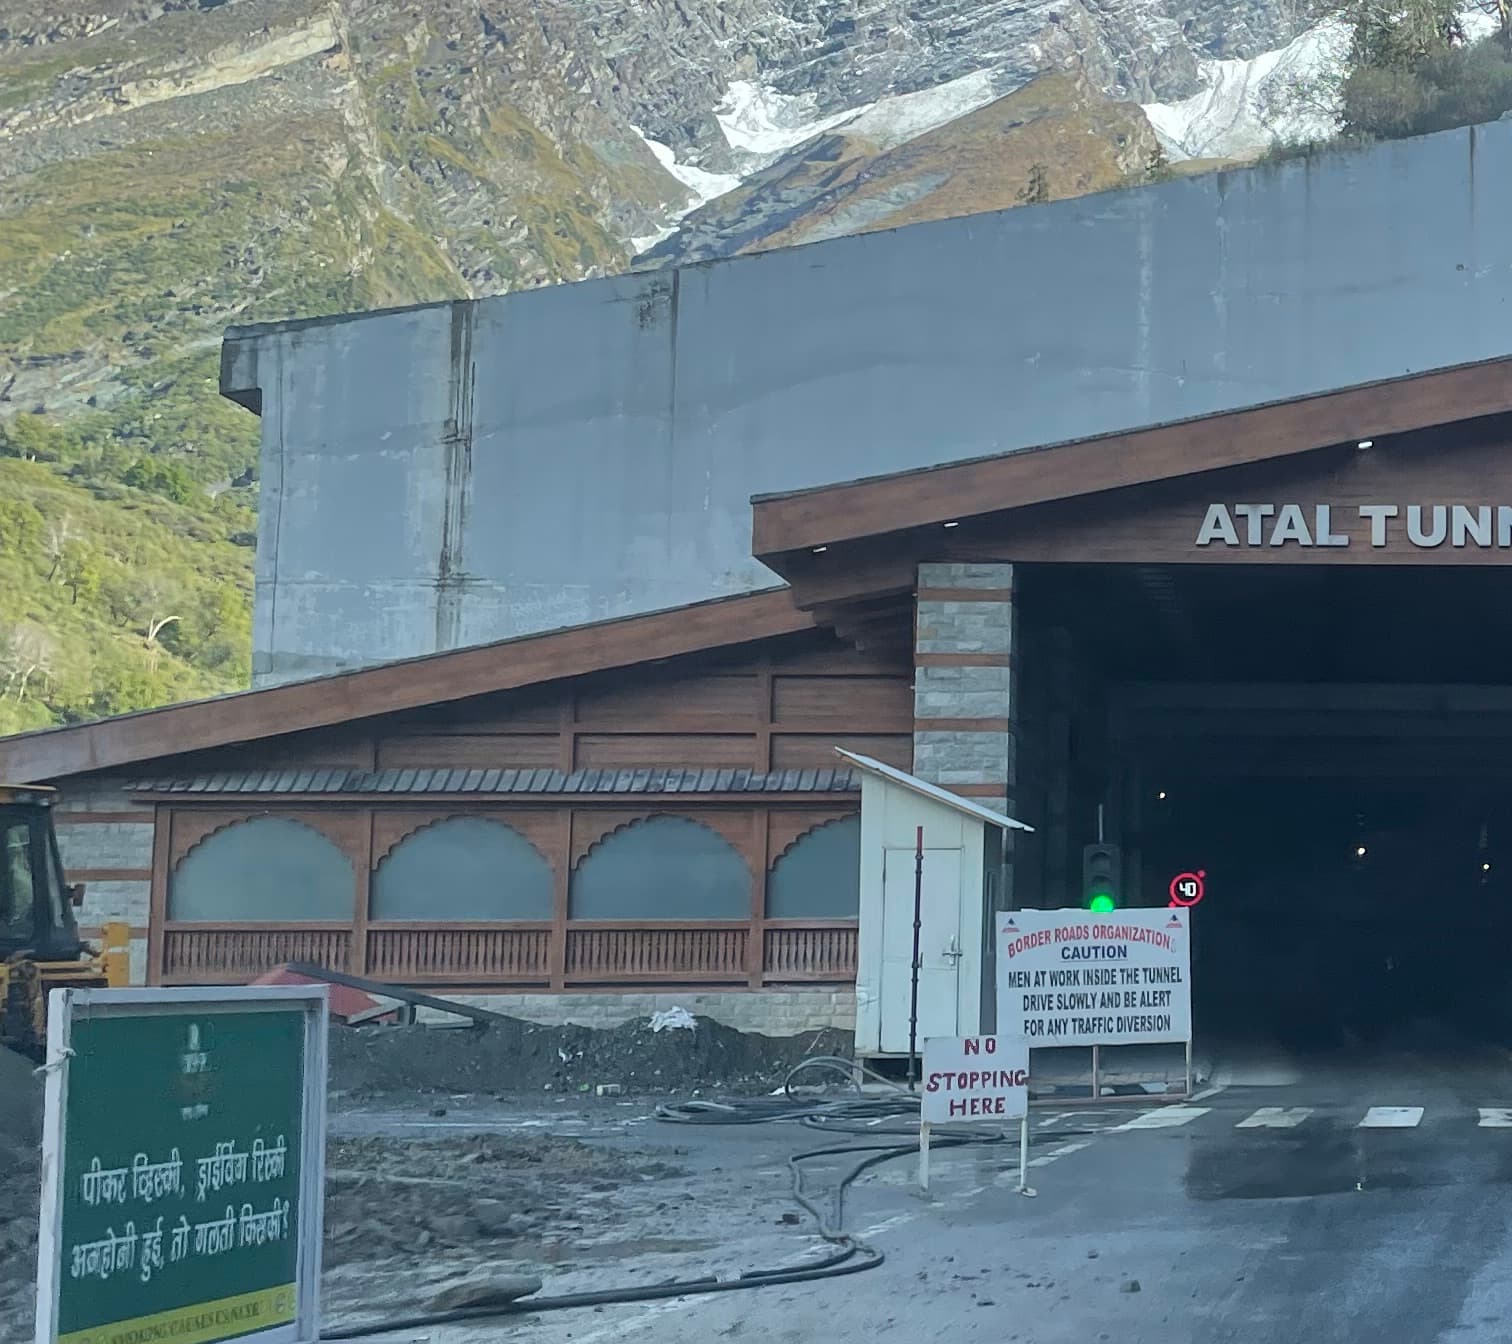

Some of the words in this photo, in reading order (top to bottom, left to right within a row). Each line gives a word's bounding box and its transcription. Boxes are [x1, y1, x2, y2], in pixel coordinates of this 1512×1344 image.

[1195, 503, 1350, 547] ATAL
[1179, 882, 1197, 897] 40
[1007, 929, 1051, 959] BORDER
[1054, 925, 1089, 943] ROADS
[1092, 924, 1171, 950] ORGANIZATION
[1061, 945, 1128, 960] CAUTION
[1008, 971, 1030, 988] MEN
[1033, 971, 1047, 987] AT
[1049, 970, 1080, 987] WORK
[1083, 968, 1117, 986] INSIDE
[1120, 968, 1139, 984] THE
[1142, 967, 1182, 984] TUNNEL
[1023, 994, 1053, 1011] DRIVE
[1056, 992, 1098, 1011] SLOWLY
[1100, 991, 1121, 1008] AND
[1124, 991, 1137, 1008] BE
[1139, 990, 1171, 1008] ALERT
[1023, 1019, 1044, 1036] FOR
[1047, 1018, 1069, 1036] ANY
[1071, 1017, 1114, 1034] TRAFFIC
[1117, 1014, 1171, 1033] DIVERSION
[964, 1038, 996, 1055] NO
[926, 1069, 1029, 1092] STOPPING
[949, 1097, 1006, 1116] HERE
[82, 1157, 128, 1205] पीकर
[71, 1220, 138, 1279] अनहोनी
[170, 1214, 191, 1262] तो
[195, 1205, 237, 1255] गलती
